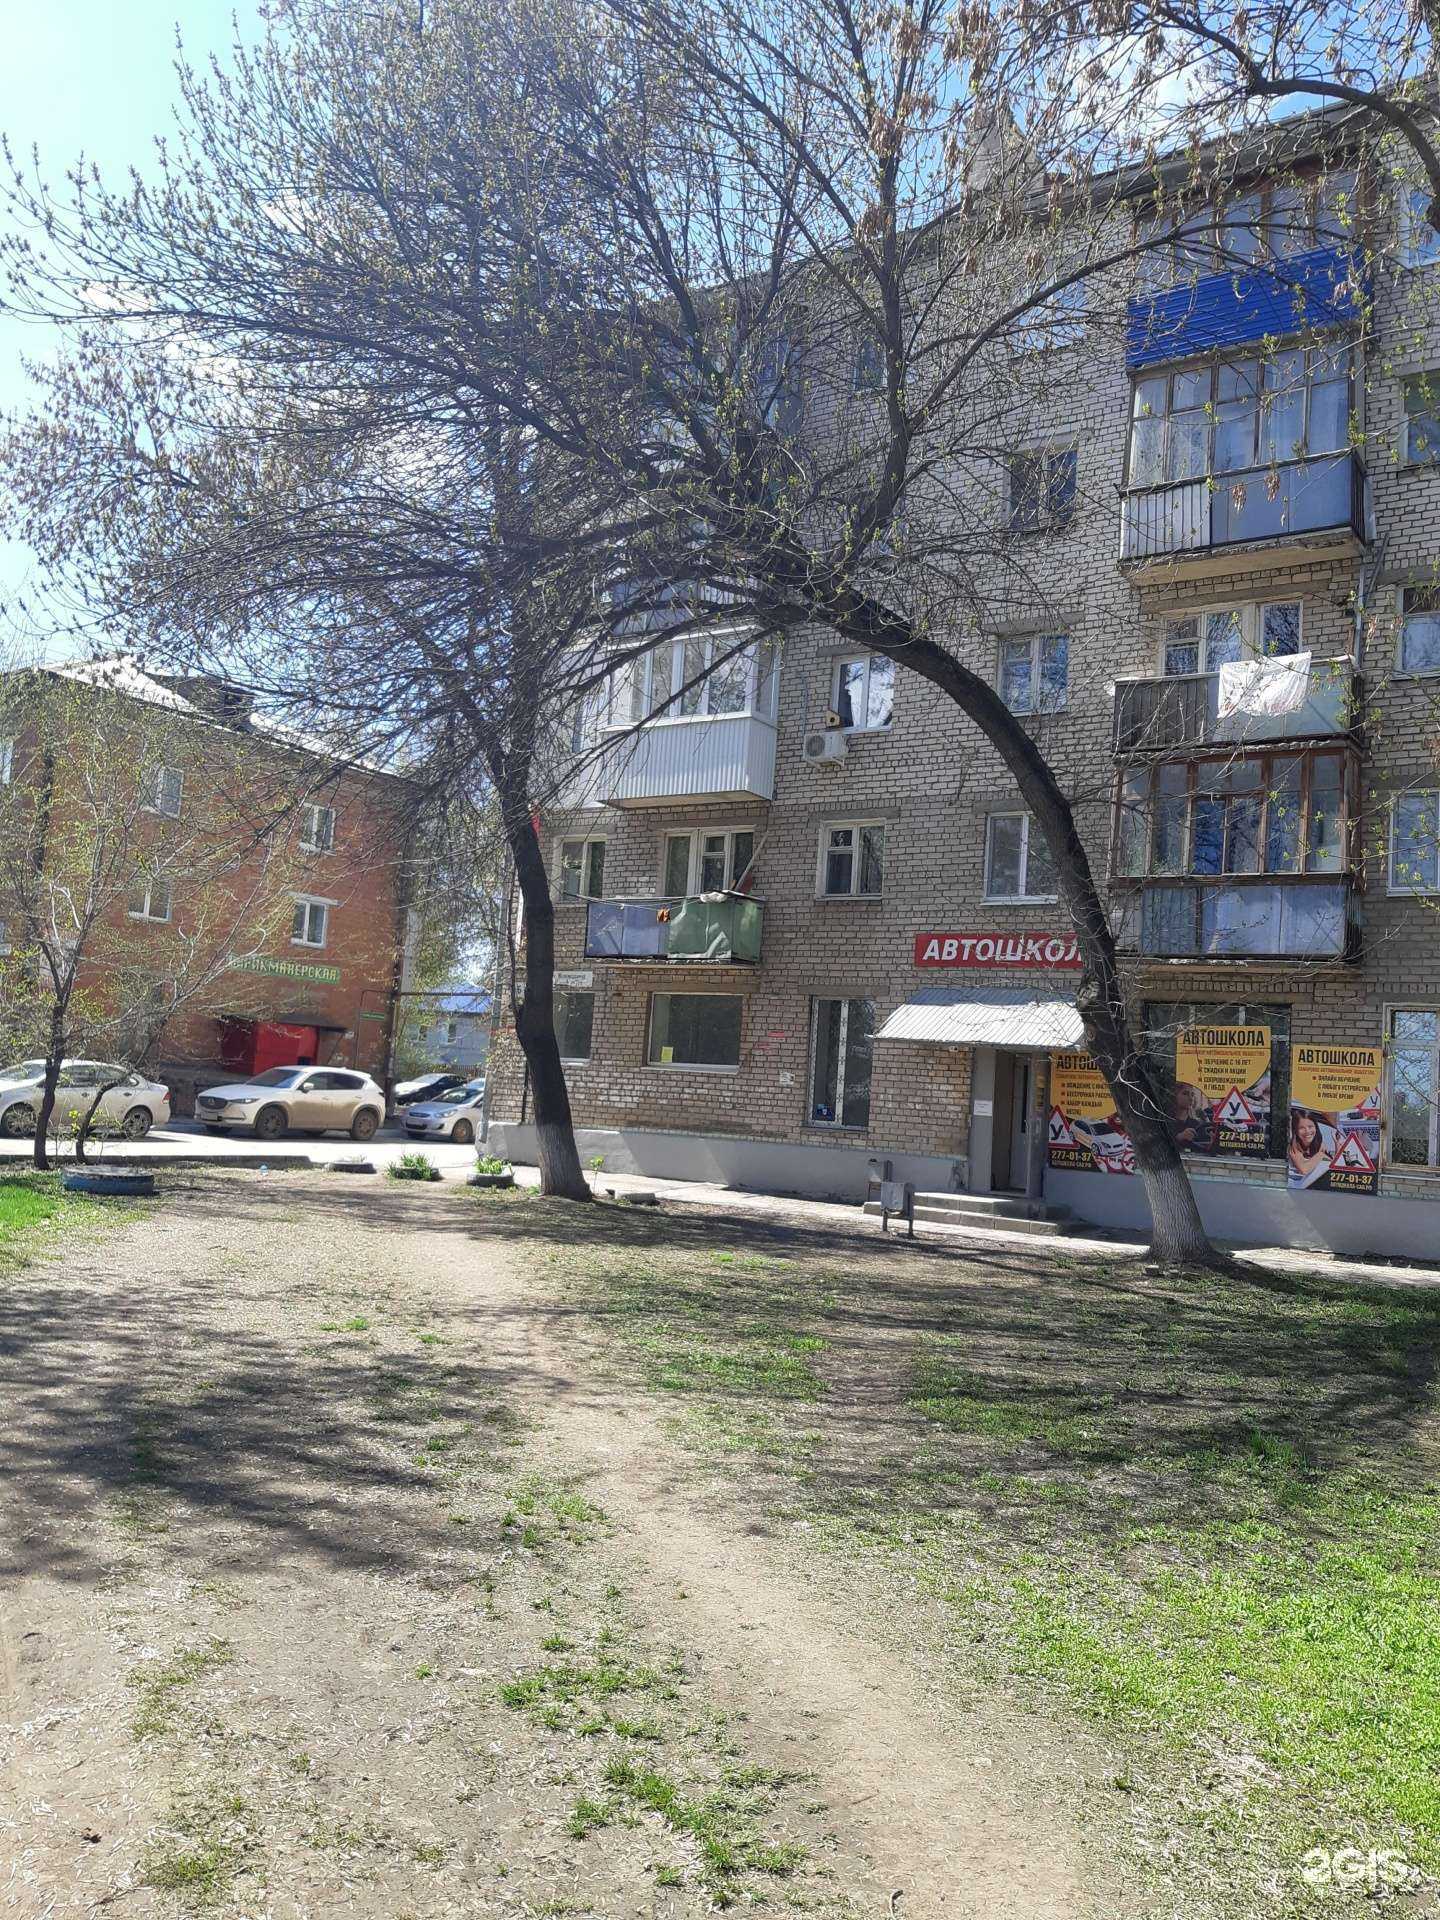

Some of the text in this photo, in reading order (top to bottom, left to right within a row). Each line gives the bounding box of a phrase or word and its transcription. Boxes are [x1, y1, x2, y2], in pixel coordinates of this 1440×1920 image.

[923, 938, 1082, 962] АВТОШКОЛ
[231, 954, 337, 980] РИКМАХЕРСКАЯ
[1183, 1030, 1265, 1047] АВТОШКОЛА
[1056, 1055, 1099, 1071] АВТОШ
[1298, 1049, 1375, 1066] АВТОШКОЛА
[1051, 1151, 1092, 1161] 277-01-37
[1330, 1172, 1373, 1184] 277-01-37
